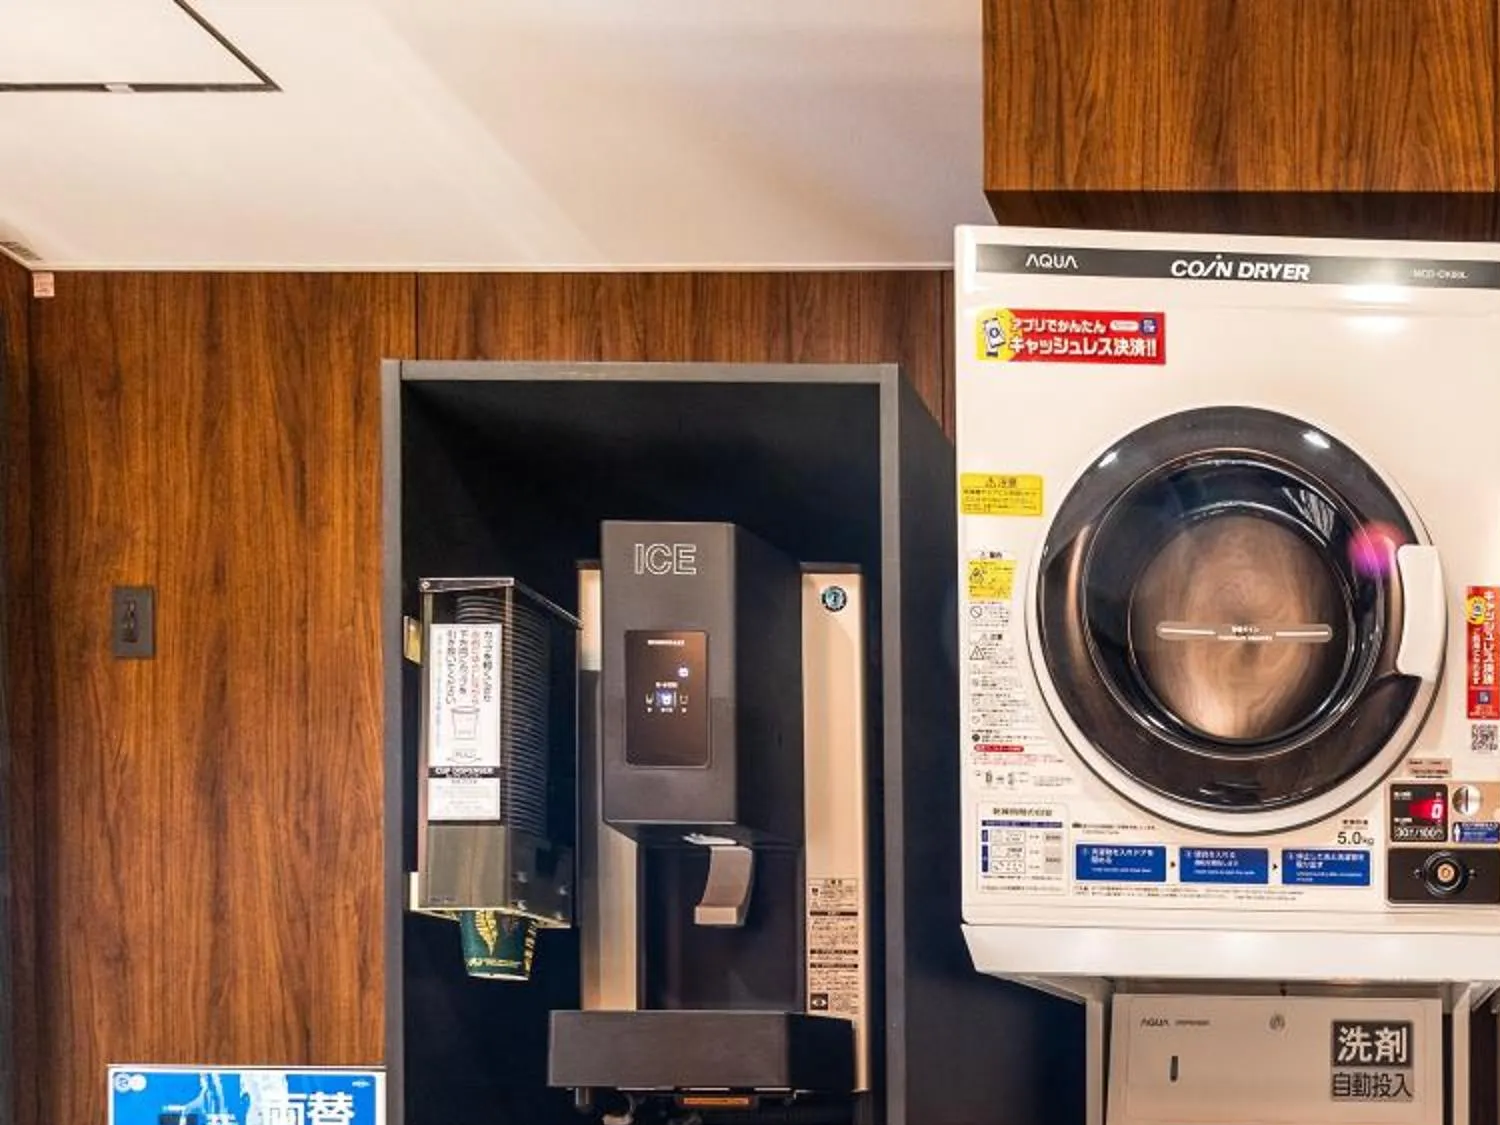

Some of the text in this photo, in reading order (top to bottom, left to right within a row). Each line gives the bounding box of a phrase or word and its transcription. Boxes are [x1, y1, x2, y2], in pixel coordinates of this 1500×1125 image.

[1025, 253, 1079, 269] AQUA
[1170, 253, 1310, 281] COIN DRYER
[634, 543, 698, 575] ICE
[1337, 1025, 1407, 1063] 洗剤
[1332, 1071, 1413, 1097] 自動投入
